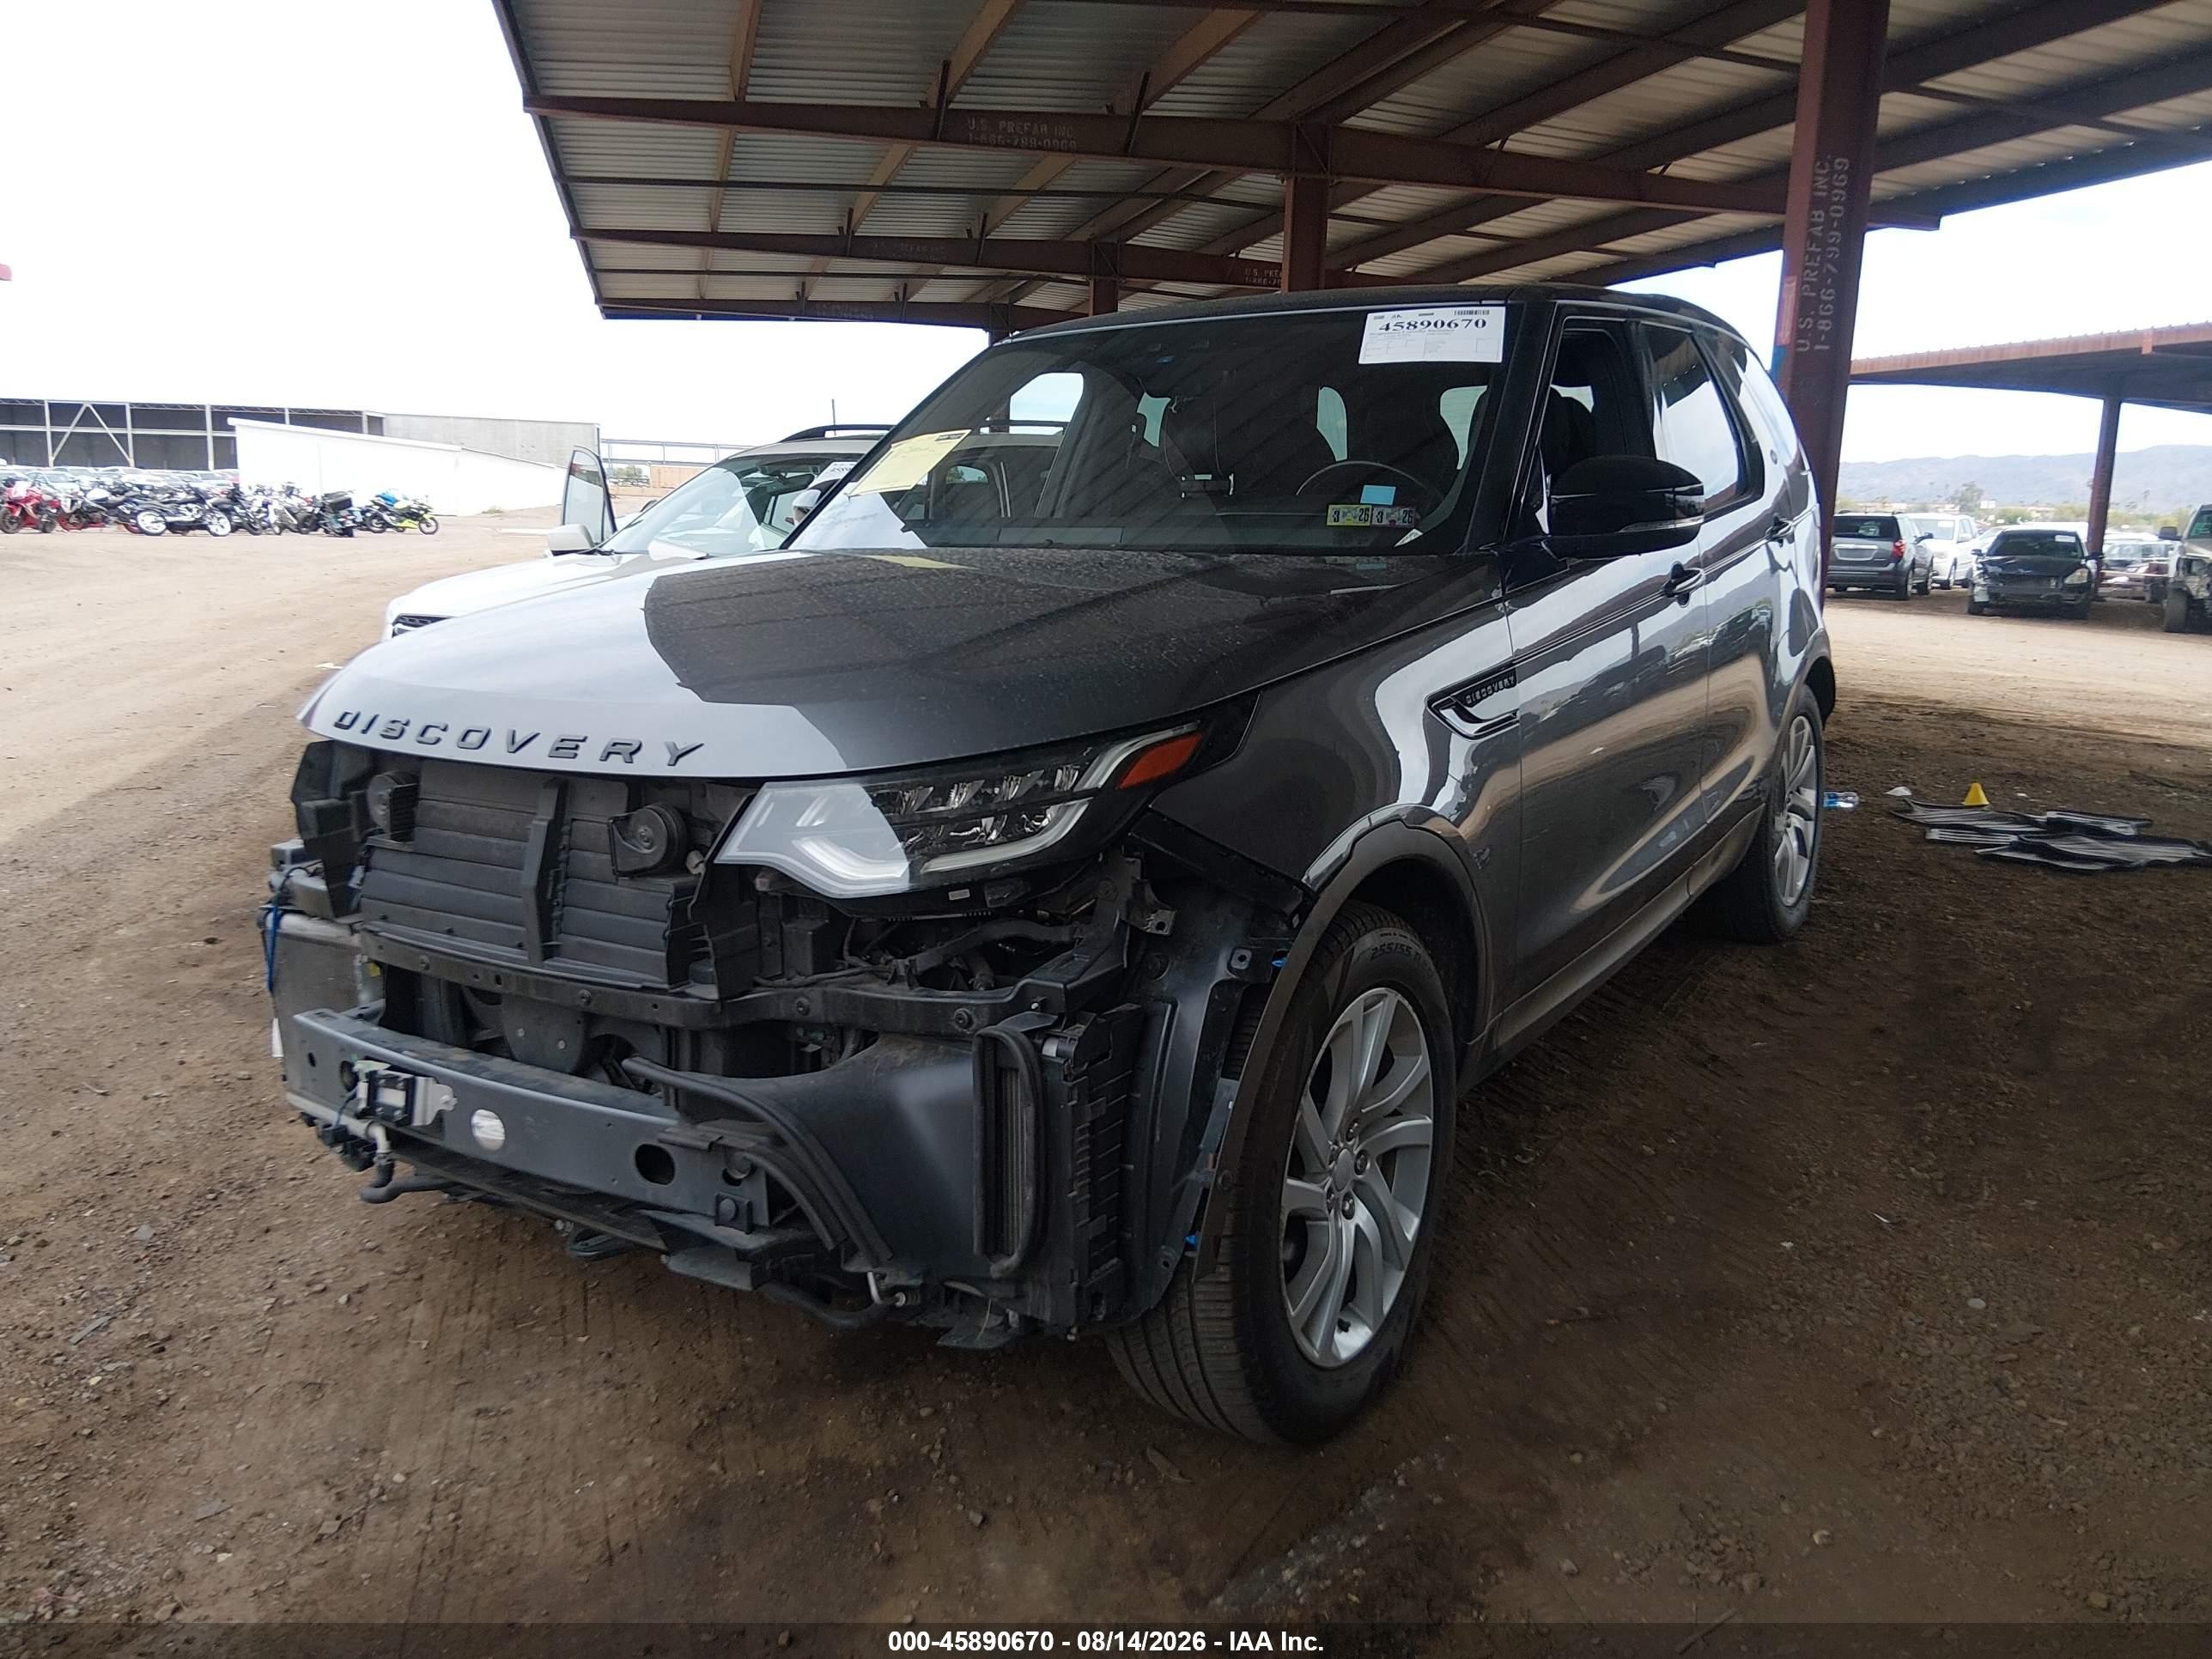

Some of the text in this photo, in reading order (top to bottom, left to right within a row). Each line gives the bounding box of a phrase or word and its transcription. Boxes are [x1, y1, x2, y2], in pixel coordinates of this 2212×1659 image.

[1796, 155, 1832, 352] U.S. PREFAB INC.
[1814, 157, 1850, 350] 1-866-799-0969
[1378, 319, 1486, 331] 45890670
[1333, 507, 1369, 523] 3 26
[1376, 509, 1413, 524] 3 26
[1466, 676, 1515, 704] DISCOVERY
[333, 710, 705, 767] DISCOVERY
